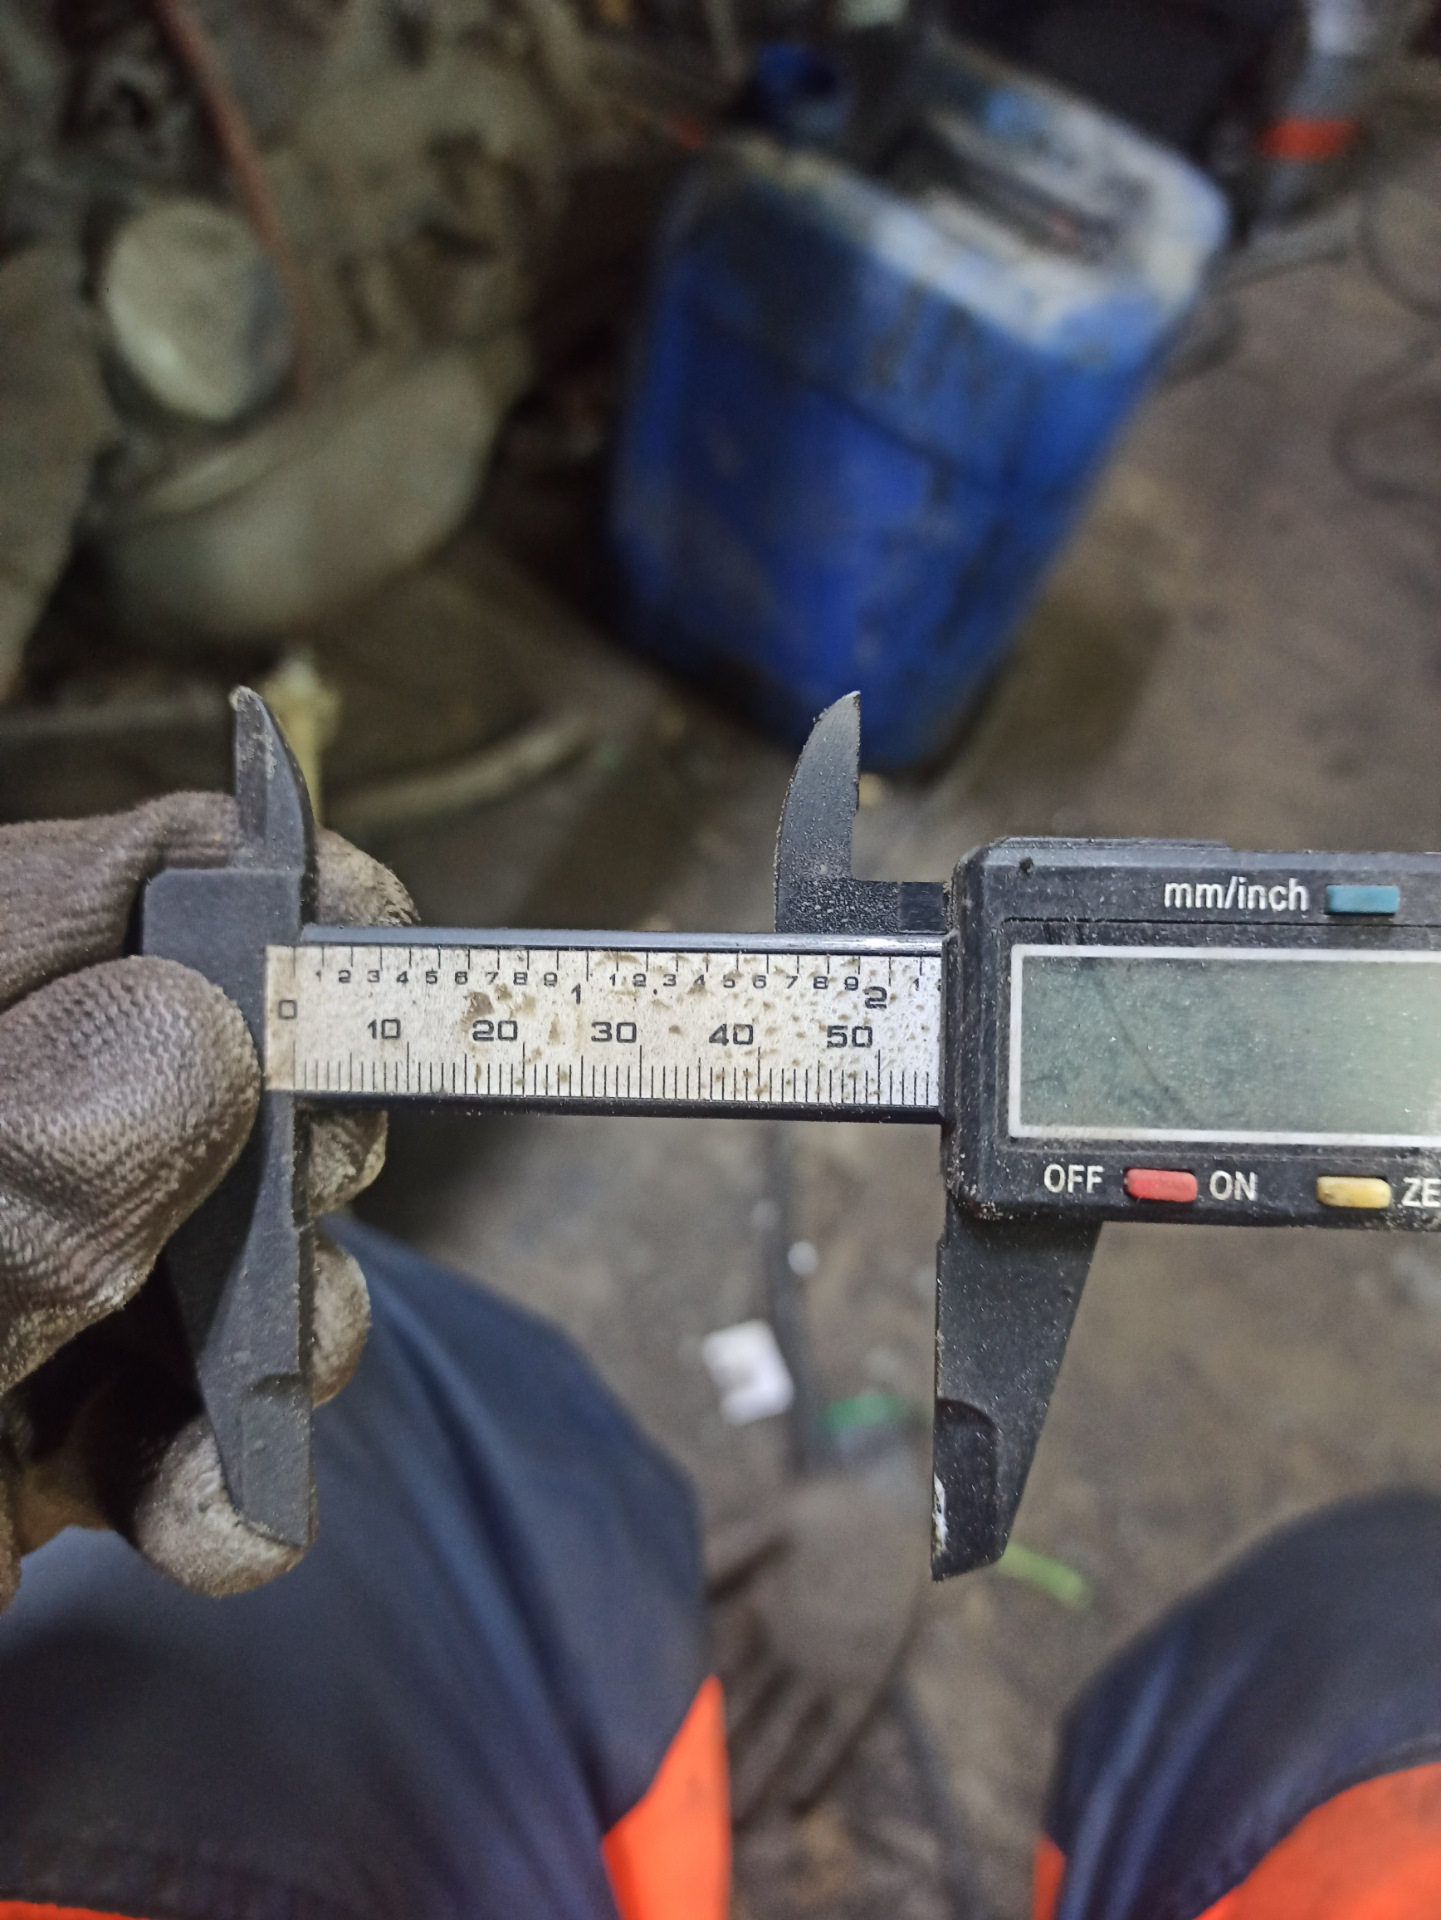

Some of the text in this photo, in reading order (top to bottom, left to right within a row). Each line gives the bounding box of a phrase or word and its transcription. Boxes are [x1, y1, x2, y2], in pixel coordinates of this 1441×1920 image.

[1164, 875, 1310, 912] mm/inch
[338, 969, 351, 984] 2
[367, 970, 380, 983] 3
[396, 971, 409, 984] 4
[425, 970, 438, 984] 5
[454, 971, 468, 985] 6
[485, 971, 499, 985] 7
[513, 971, 528, 986] 8
[543, 972, 558, 987] 9
[571, 983, 581, 1005] 1
[609, 973, 616, 987] 1
[633, 973, 647, 987] 2
[663, 973, 677, 987] 3
[693, 974, 705, 986] 4
[723, 974, 736, 988] 5
[752, 975, 767, 989] 6
[785, 975, 799, 989] 7
[813, 976, 829, 990] 8
[844, 976, 859, 991] 9
[863, 986, 888, 1009] 2
[278, 999, 873, 1048] 0 10 20 30 40 50
[1043, 1164, 1104, 1194] OFF
[1209, 1171, 1258, 1201] ON
[1401, 1177, 1441, 1209] ZE
